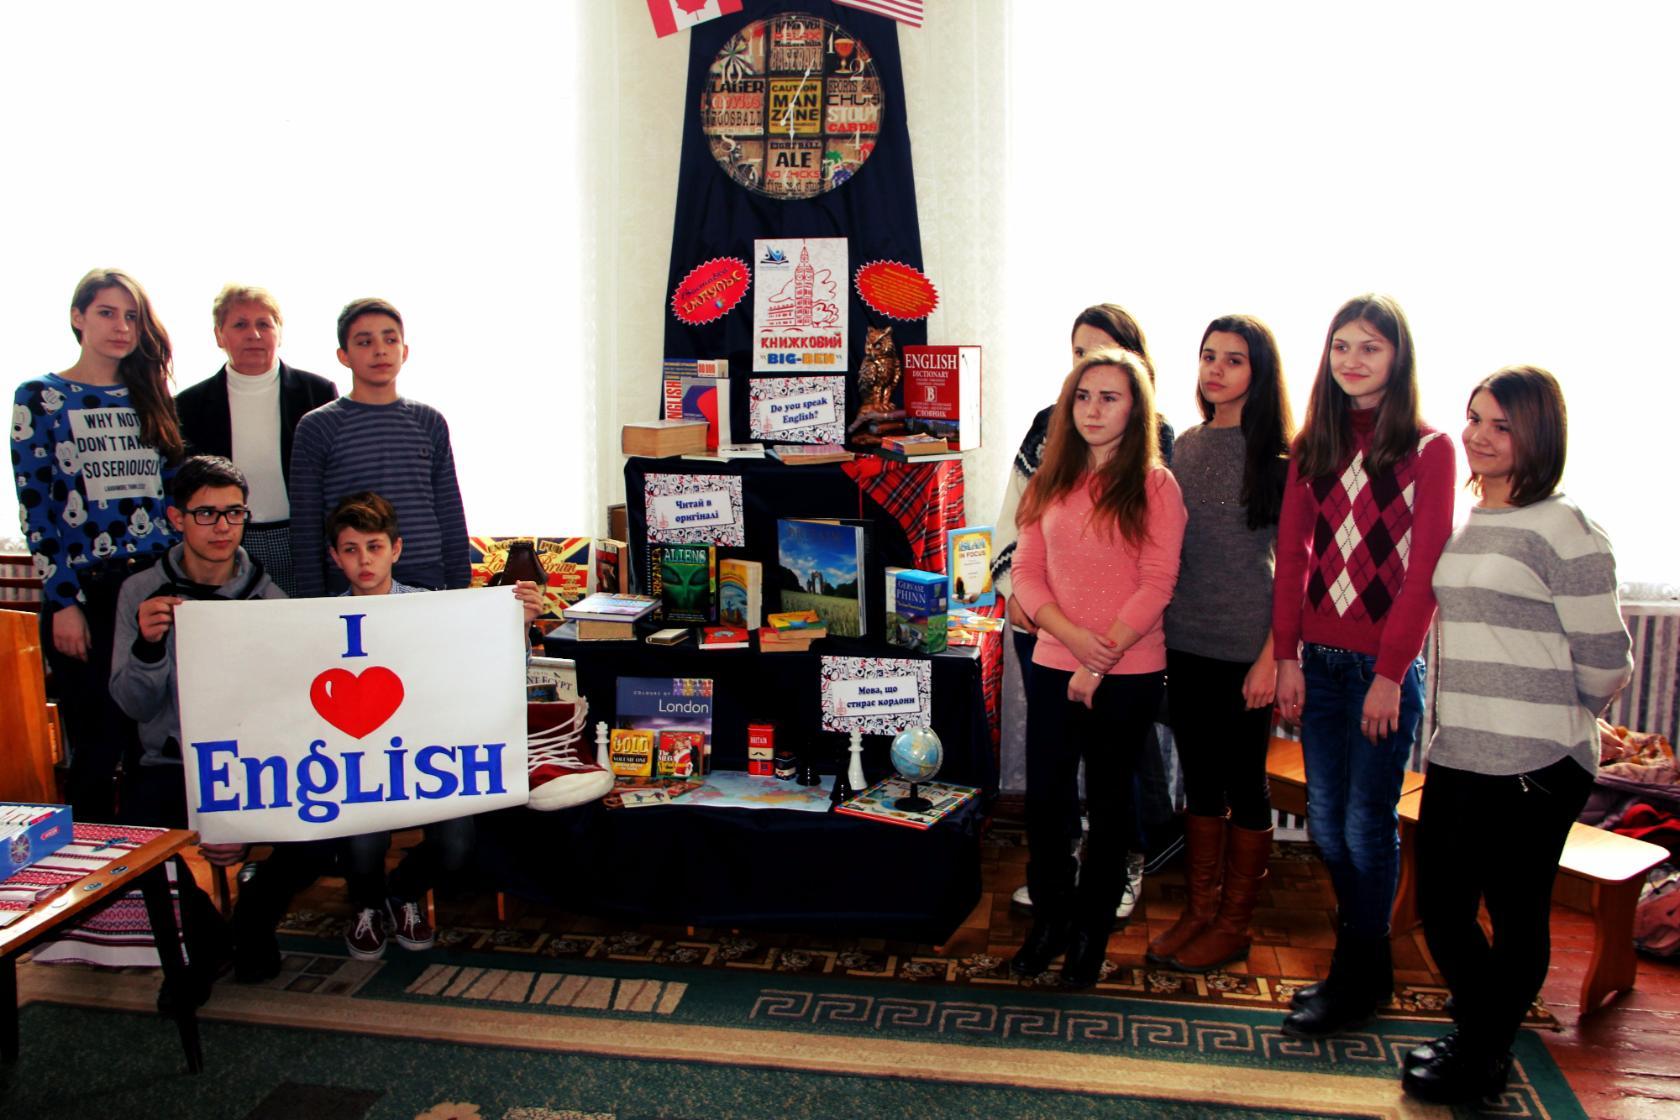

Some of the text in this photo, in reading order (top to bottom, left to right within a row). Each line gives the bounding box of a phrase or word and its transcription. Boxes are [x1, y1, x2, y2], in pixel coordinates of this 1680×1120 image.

[774, 94, 817, 108] MAN
[771, 109, 819, 121] ZONE
[776, 151, 812, 168] ALE
[761, 332, 842, 348] КНИЖКОВИЙ
[905, 354, 957, 369] ENGLISH
[666, 381, 682, 420] NGLISH
[771, 397, 828, 413] Do you speak
[84, 413, 140, 428] WHY NOT
[783, 410, 818, 423] English?
[77, 435, 116, 452] DON'T
[83, 461, 101, 478] SO
[675, 499, 704, 509] Читай
[675, 511, 719, 523] оригіналі
[663, 548, 706, 563] ALIENS
[897, 589, 926, 603] PHINN
[339, 614, 368, 658] I
[859, 685, 898, 695] Мова, що
[659, 698, 709, 713] London
[877, 697, 915, 707] кордони
[613, 736, 649, 753] GOLD
